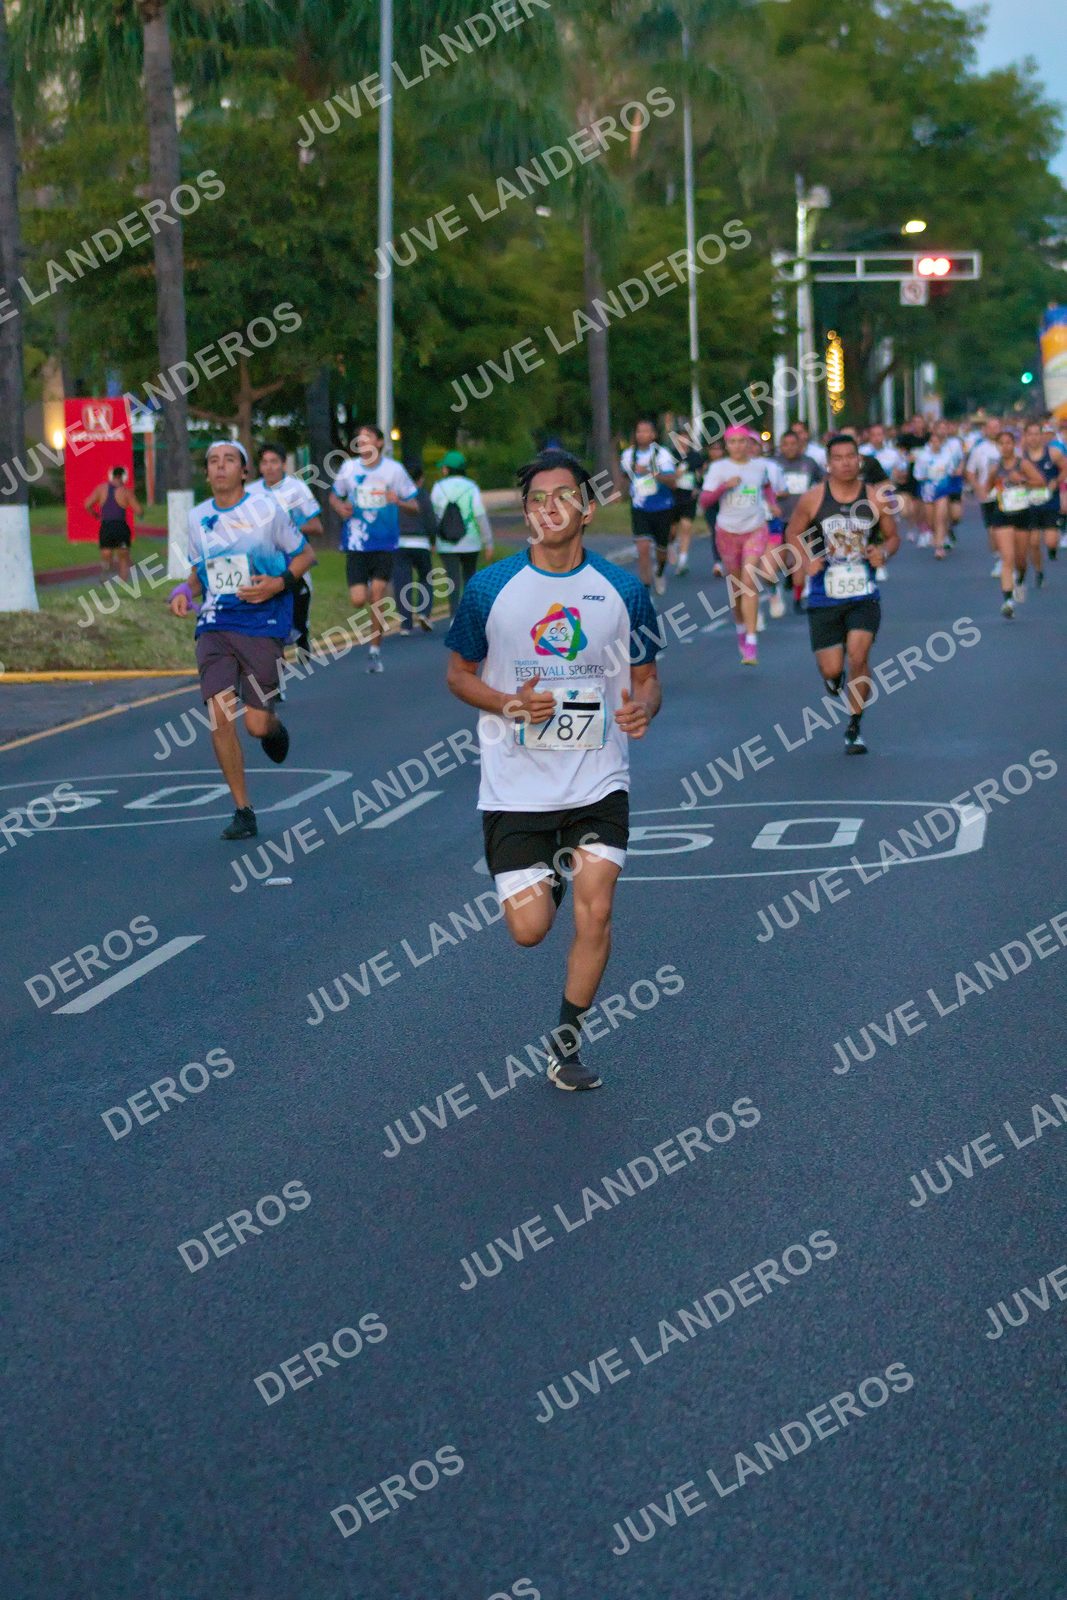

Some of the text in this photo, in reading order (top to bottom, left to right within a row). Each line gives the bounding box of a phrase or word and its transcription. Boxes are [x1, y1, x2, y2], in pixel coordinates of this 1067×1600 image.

[216, 571, 243, 590] 542
[515, 664, 604, 677] FESTIVALL SPORTS
[537, 714, 595, 740] 787
